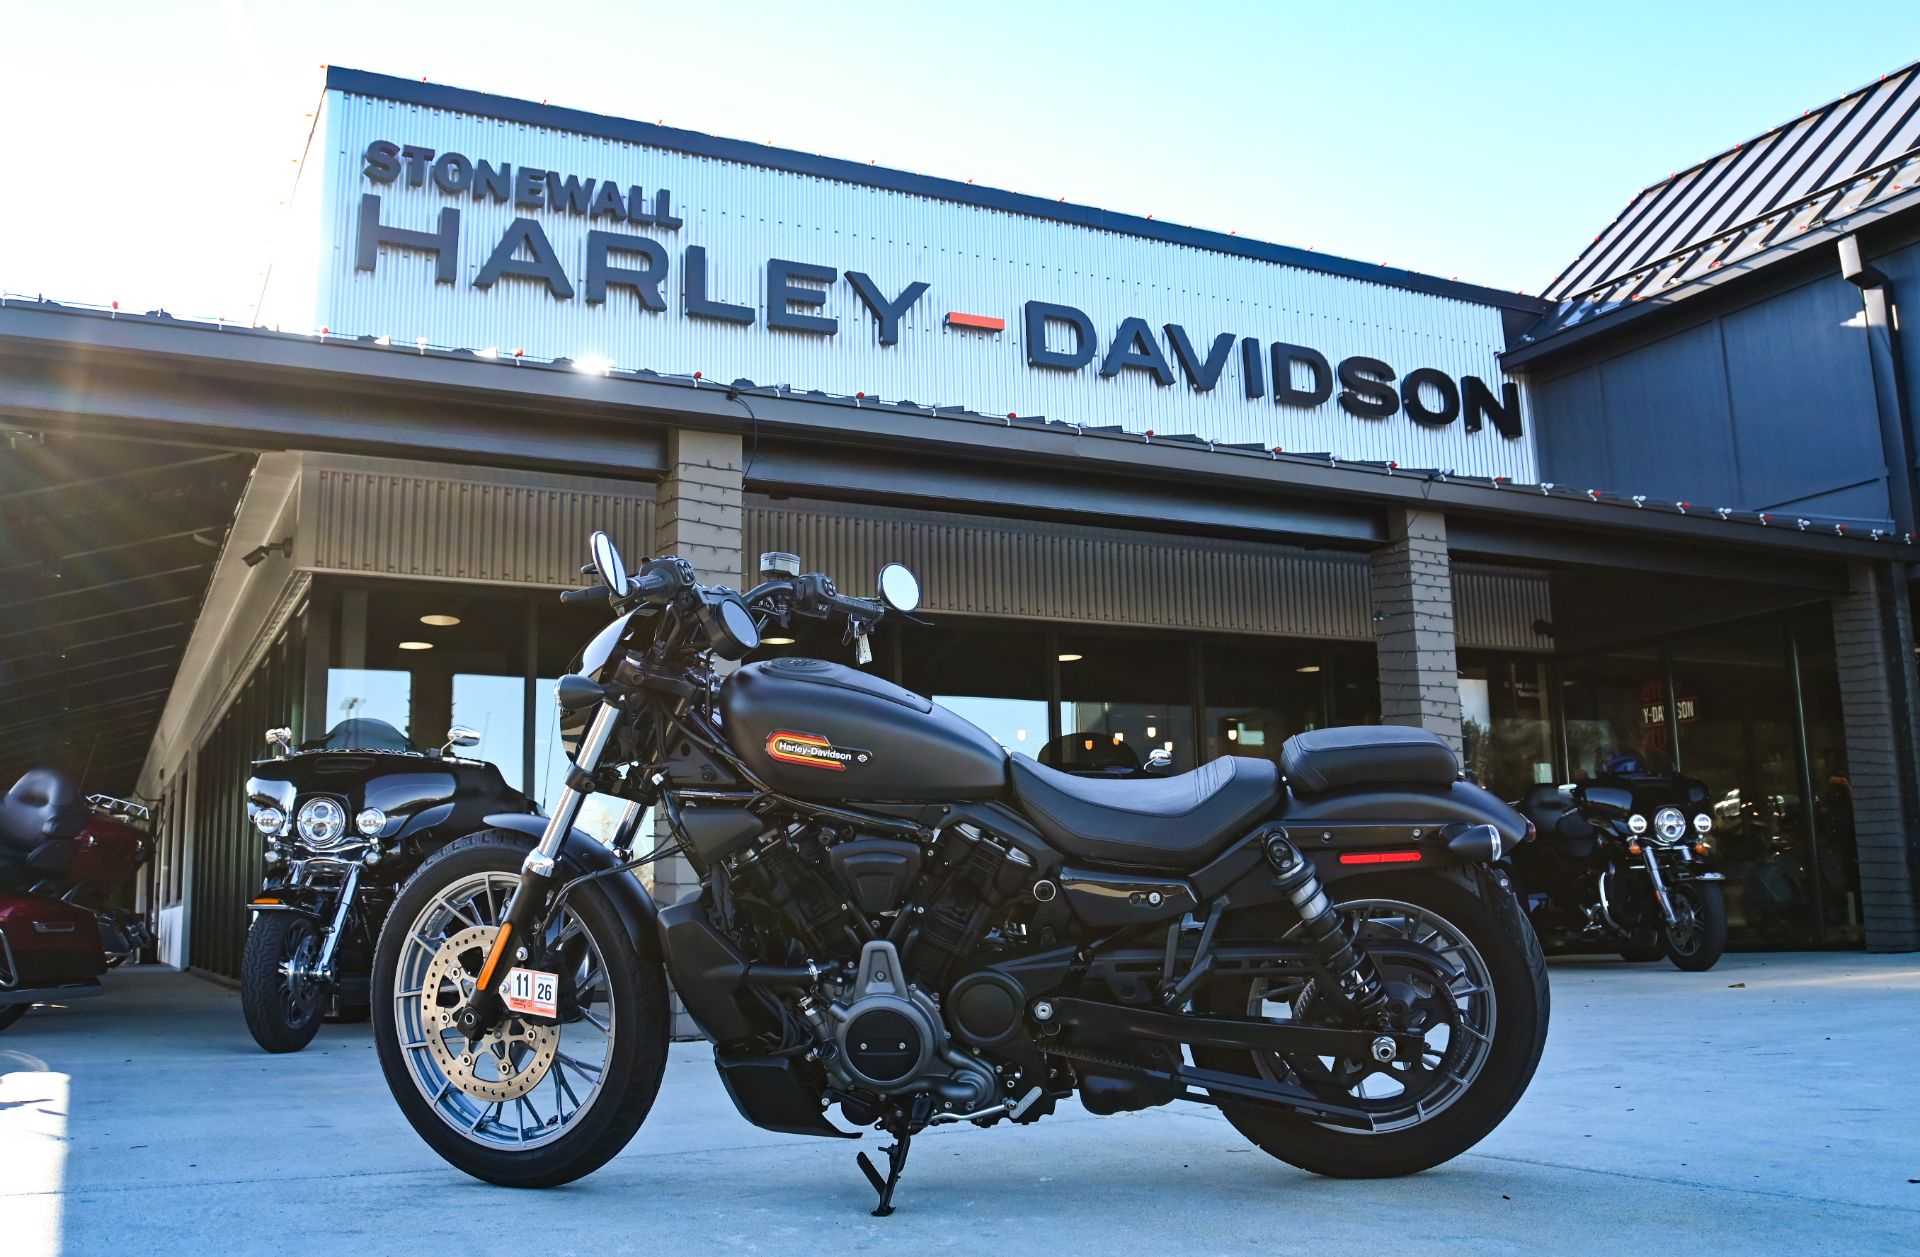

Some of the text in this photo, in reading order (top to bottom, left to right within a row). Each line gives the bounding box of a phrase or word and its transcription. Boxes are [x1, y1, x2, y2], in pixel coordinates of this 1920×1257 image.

[363, 140, 683, 230] STONEWALL
[779, 741, 852, 761] Harley-Davidson
[516, 973, 529, 997] 11
[537, 983, 552, 1001] 26
